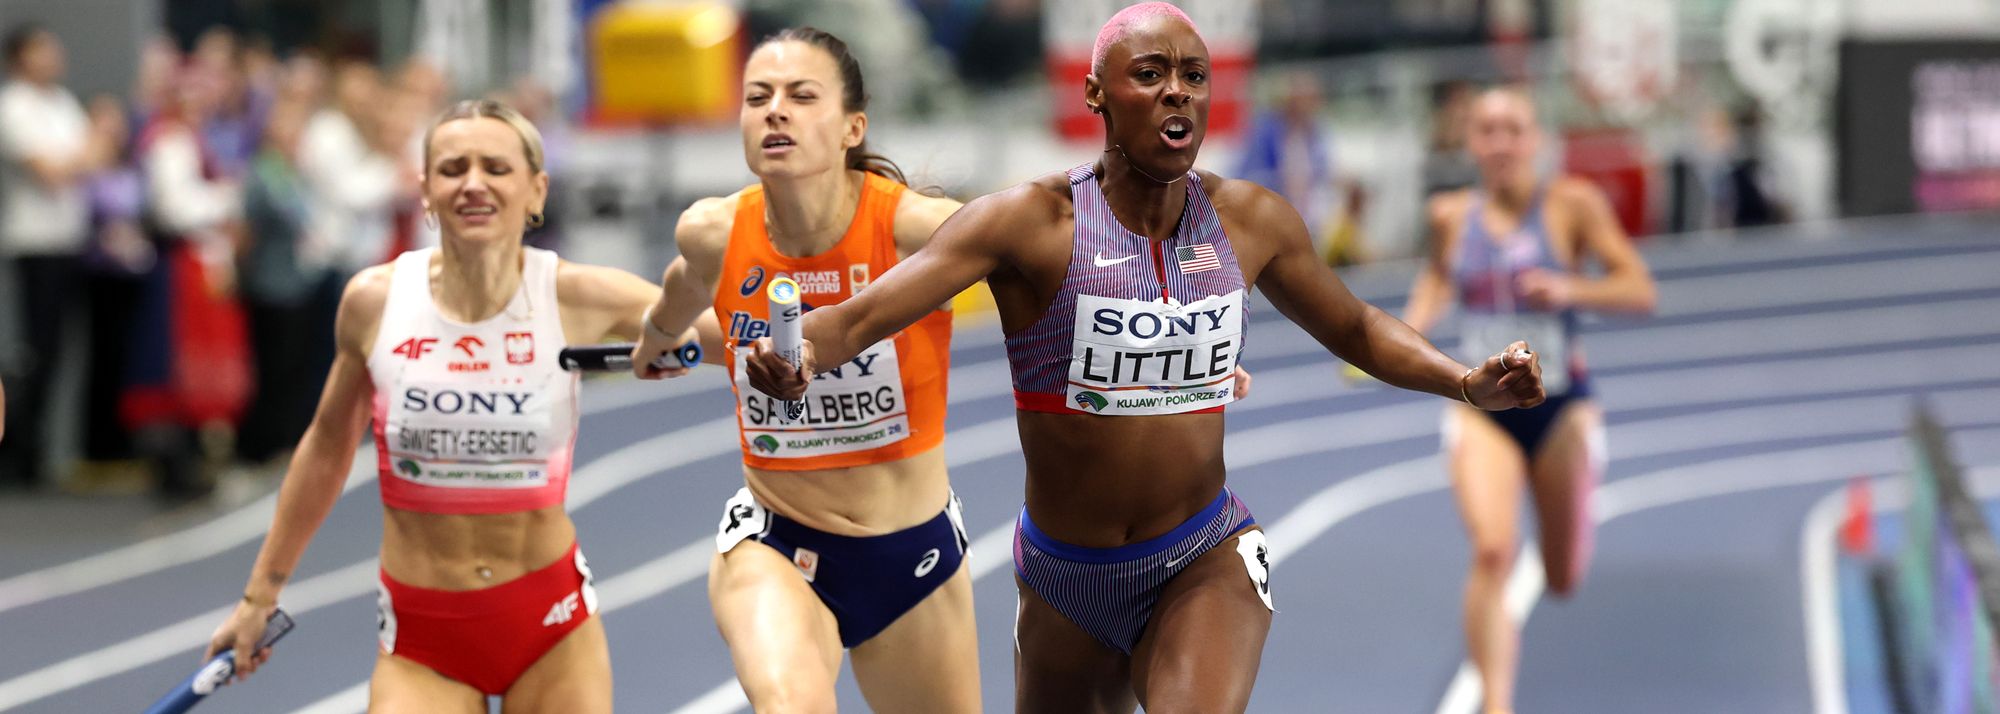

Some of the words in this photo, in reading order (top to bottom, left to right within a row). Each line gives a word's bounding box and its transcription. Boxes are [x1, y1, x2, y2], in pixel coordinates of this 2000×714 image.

[793, 271, 840, 283] STAATS
[800, 282, 840, 294] OTERIJ
[1093, 305, 1230, 339] SONY
[1083, 340, 1231, 383] LITTLE
[404, 387, 533, 414] SONY
[748, 386, 895, 425] SALBERG
[1116, 397, 1163, 409] KUJAWY
[1165, 391, 1216, 406] POMORZE
[1217, 388, 1229, 399] 26
[787, 435, 831, 449] KUJAWY
[833, 429, 886, 445] POMORZE
[888, 423, 902, 435] 26
